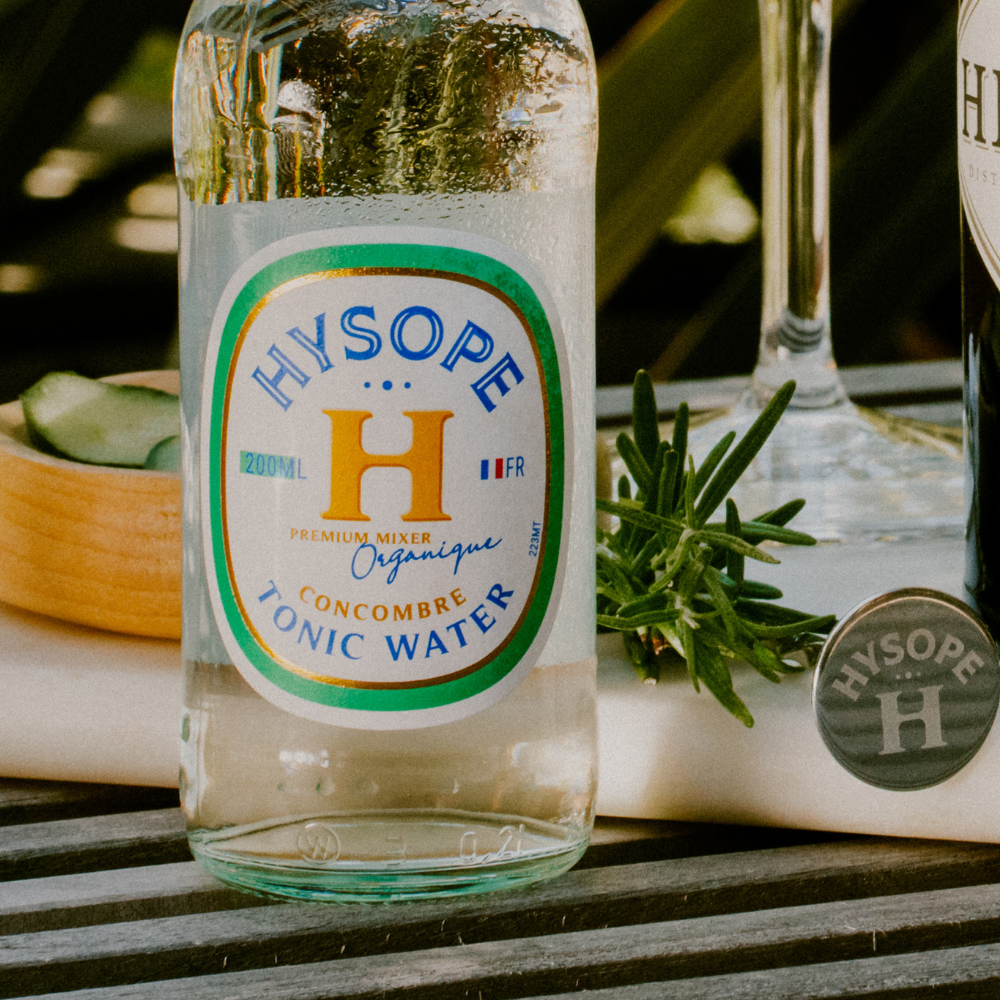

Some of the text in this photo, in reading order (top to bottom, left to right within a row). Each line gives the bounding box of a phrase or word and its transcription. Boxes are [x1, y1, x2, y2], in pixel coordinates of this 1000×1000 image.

[251, 305, 525, 413] HYSOPE
[245, 451, 308, 480] 200ML
[319, 408, 455, 522] H
[506, 455, 526, 479] FR
[290, 527, 431, 546] PREMIUM MIXER
[528, 521, 541, 557] 223MT
[351, 537, 502, 584] Organique
[257, 580, 515, 662] TONIC WATER
[299, 585, 467, 622] CONCOMBRE
[831, 628, 985, 702] HYSOPE
[875, 684, 948, 756] H
